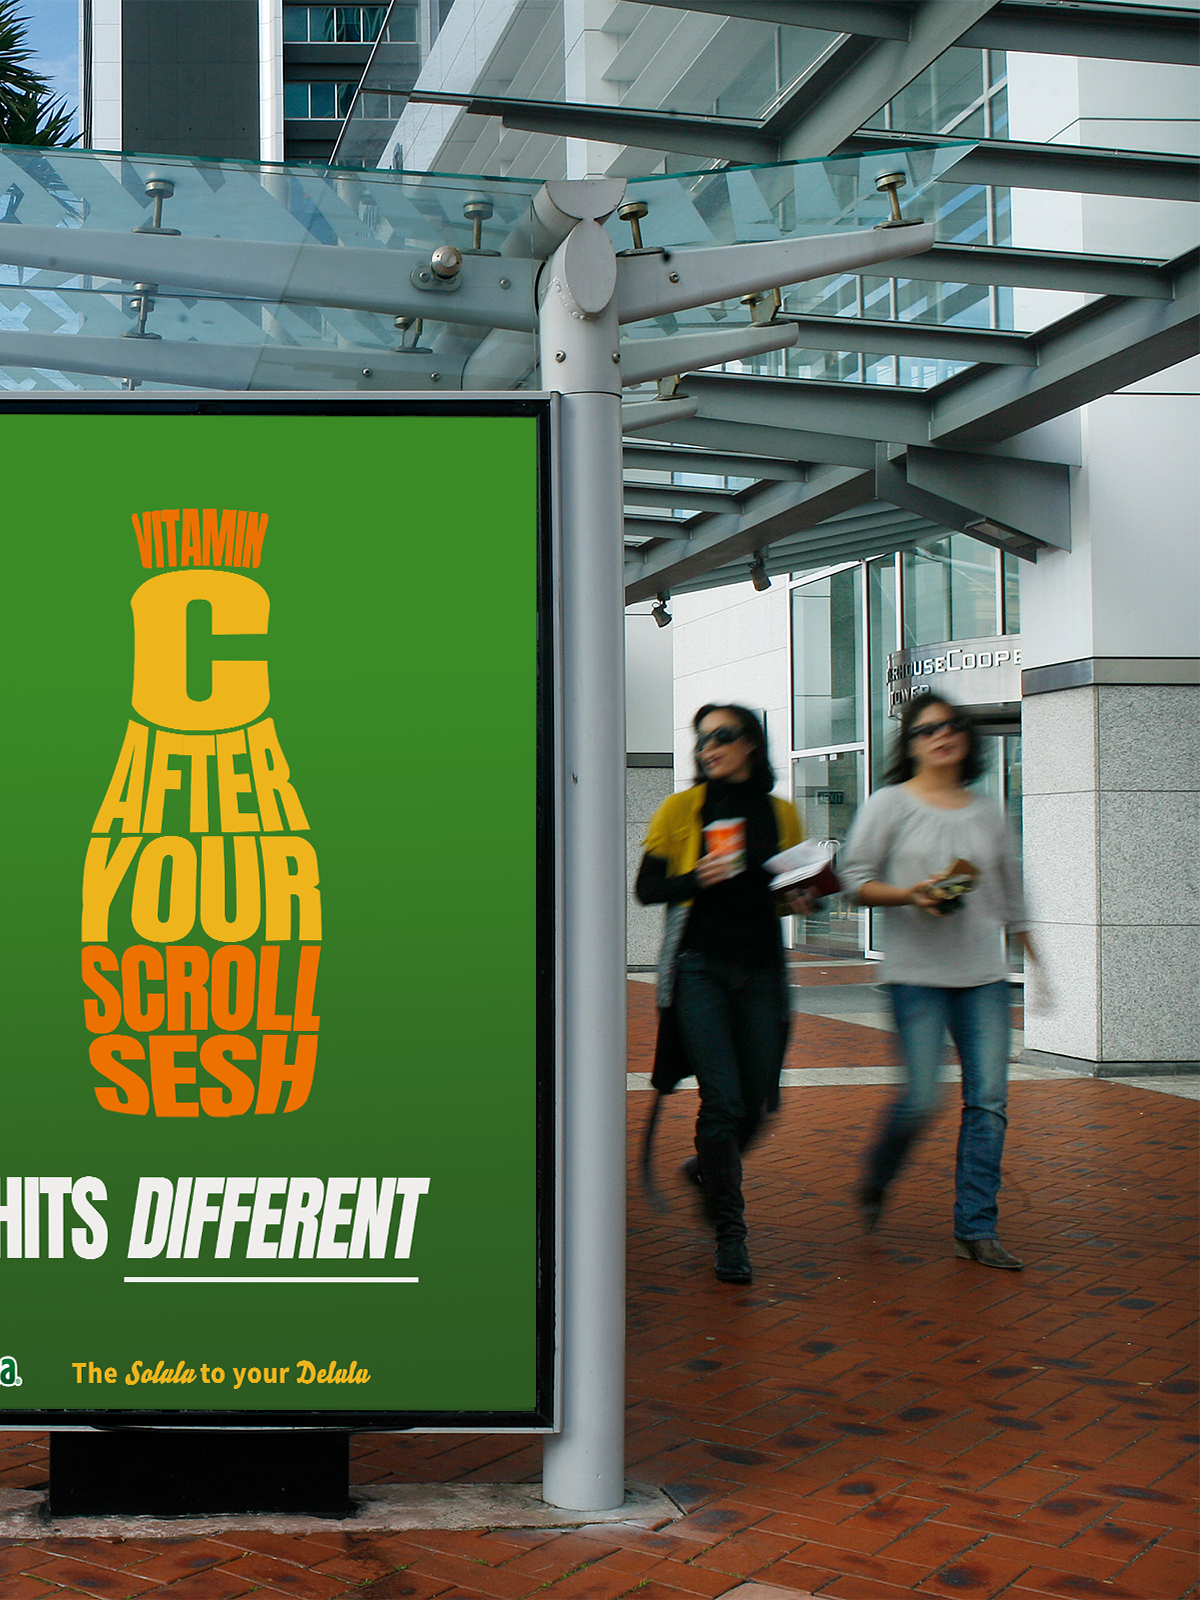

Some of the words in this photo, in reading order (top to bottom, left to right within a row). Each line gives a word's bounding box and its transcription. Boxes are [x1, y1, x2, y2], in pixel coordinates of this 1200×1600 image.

[131, 508, 270, 569] VITAMIN
[130, 569, 271, 731] C
[91, 717, 311, 833] AFTER
[81, 835, 323, 943] YOUR
[81, 945, 322, 1034] SCROLL
[88, 1034, 319, 1118] SESH
[127, 1176, 431, 1259] DIFFERENT
[71, 1361, 118, 1384] The
[125, 1360, 198, 1386] Solulu
[200, 1363, 226, 1384] to
[232, 1367, 290, 1390] your
[296, 1360, 371, 1385] Delulu
